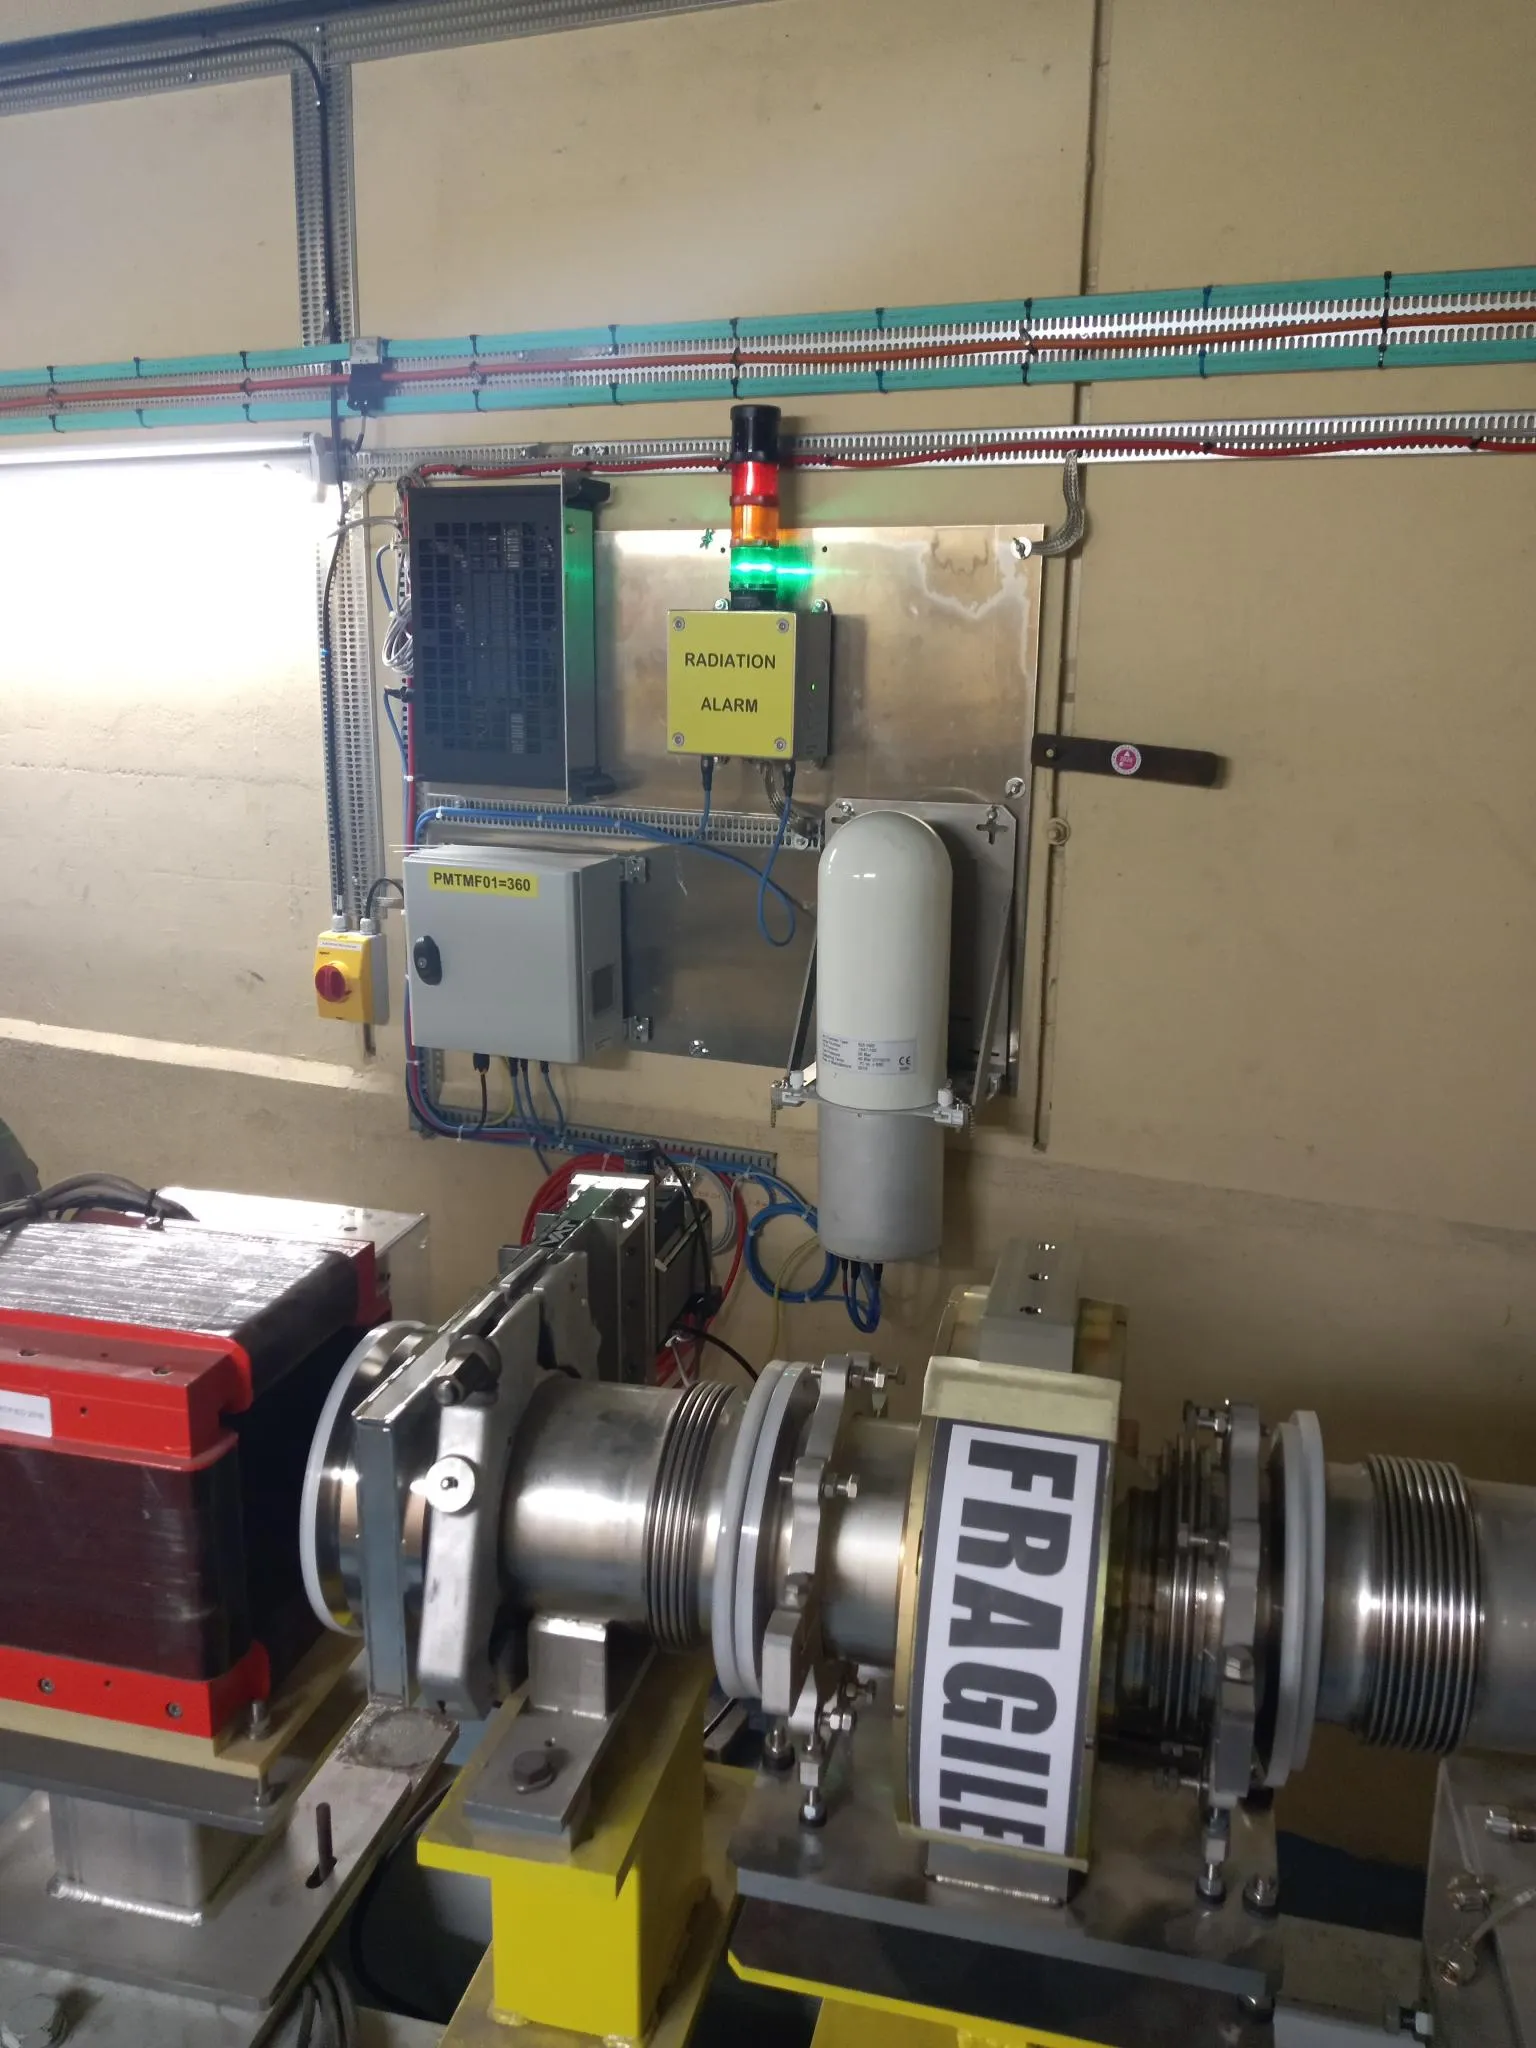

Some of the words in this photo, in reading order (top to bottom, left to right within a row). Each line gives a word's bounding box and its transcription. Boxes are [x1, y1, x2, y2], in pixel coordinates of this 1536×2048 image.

[684, 652, 776, 669] RADIATION
[701, 697, 758, 713] ALARM
[433, 871, 531, 891] PMTMF01=360
[898, 1056, 911, 1066] CE
[940, 1439, 1077, 1848] FRAGILE
